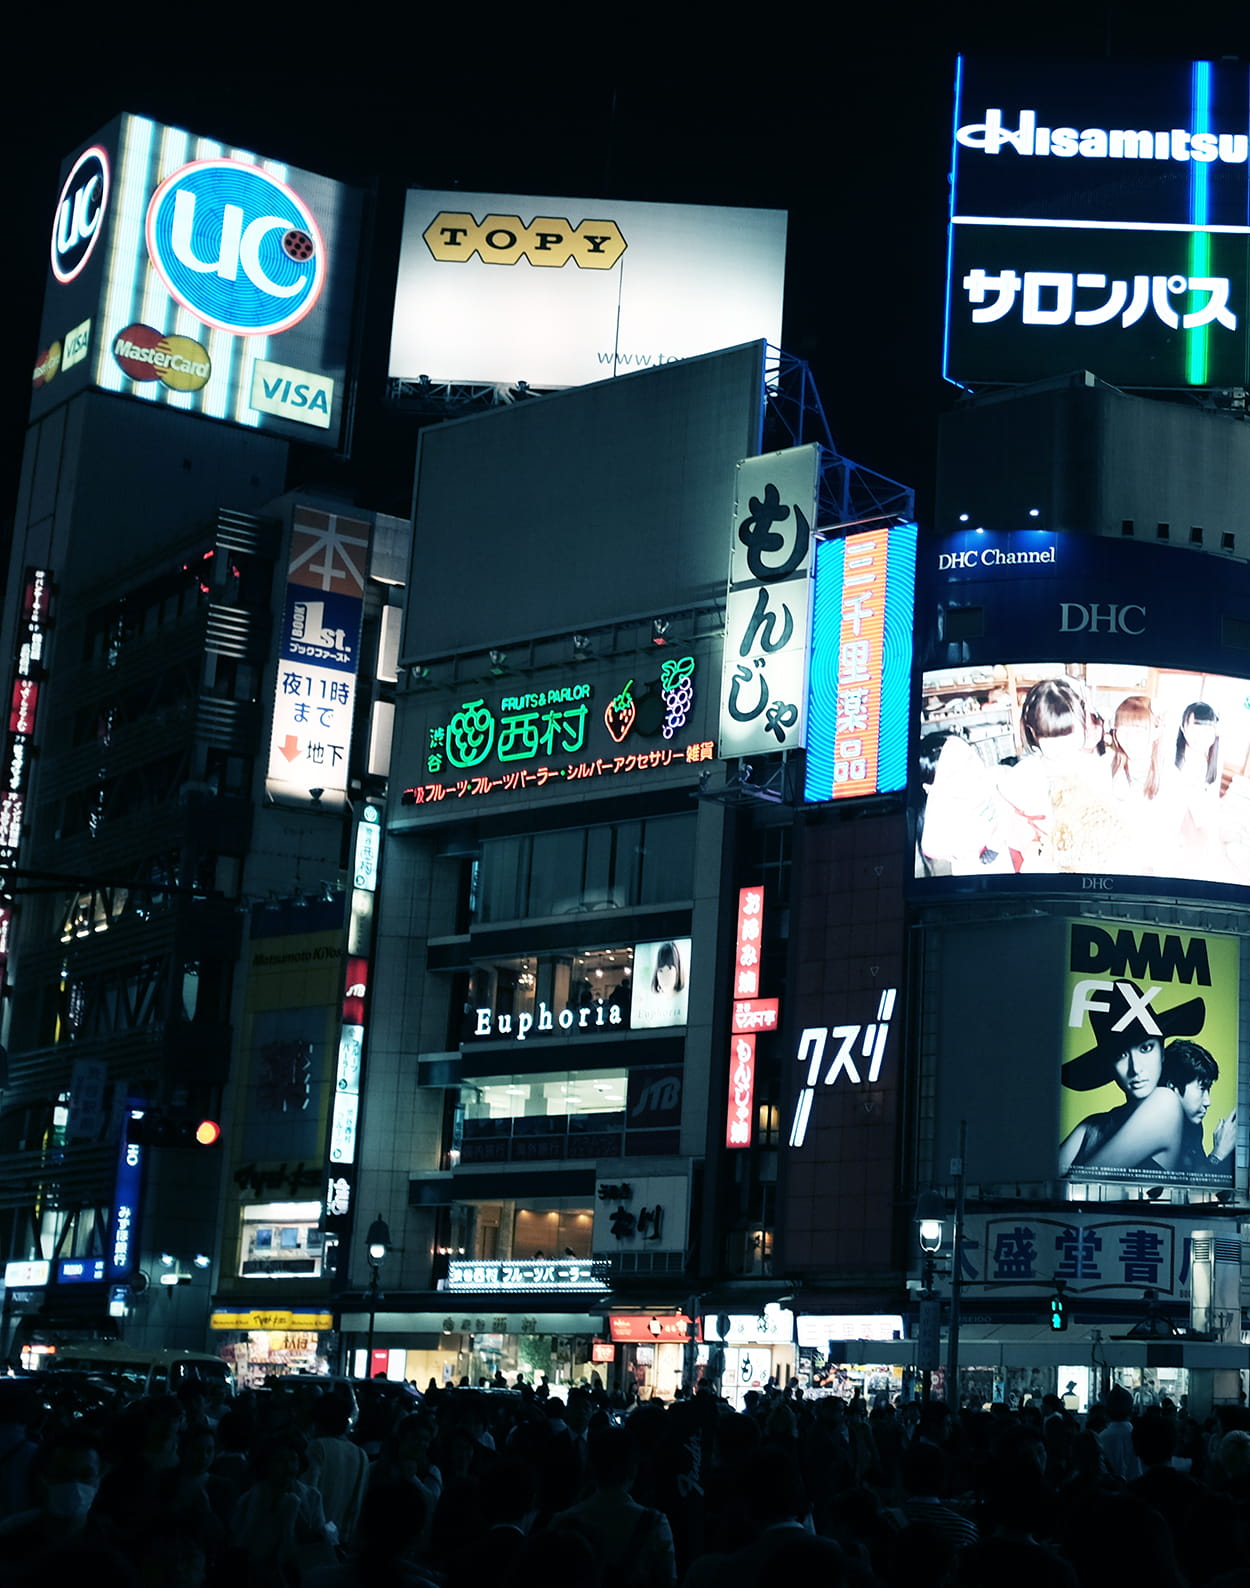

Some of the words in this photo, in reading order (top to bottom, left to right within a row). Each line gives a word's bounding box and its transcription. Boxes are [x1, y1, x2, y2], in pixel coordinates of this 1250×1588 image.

[956, 108, 1249, 163] Hisamitsu
[440, 228, 612, 253] TOPY
[963, 269, 1237, 331] サロンパス
[115, 339, 210, 379] MasterCard
[598, 351, 693, 368] www.to
[262, 378, 328, 415] VISA
[938, 550, 978, 571] DHC
[981, 546, 1056, 566] Channel
[728, 483, 809, 743] もんじゃ
[1059, 603, 1147, 635] DHC
[289, 642, 351, 663] ブックファースト
[834, 541, 877, 783] 三千里薬品
[282, 671, 349, 705] 夜11時
[293, 702, 334, 728] まで
[498, 705, 588, 763] 西村
[305, 740, 345, 768] 地下
[427, 727, 444, 773] 渋谷
[1081, 877, 1114, 889] DHC
[1070, 922, 1212, 986] DMM
[474, 998, 623, 1041] Euphoria
[1068, 979, 1164, 1037] FX
[631, 1075, 681, 1118] JTB
